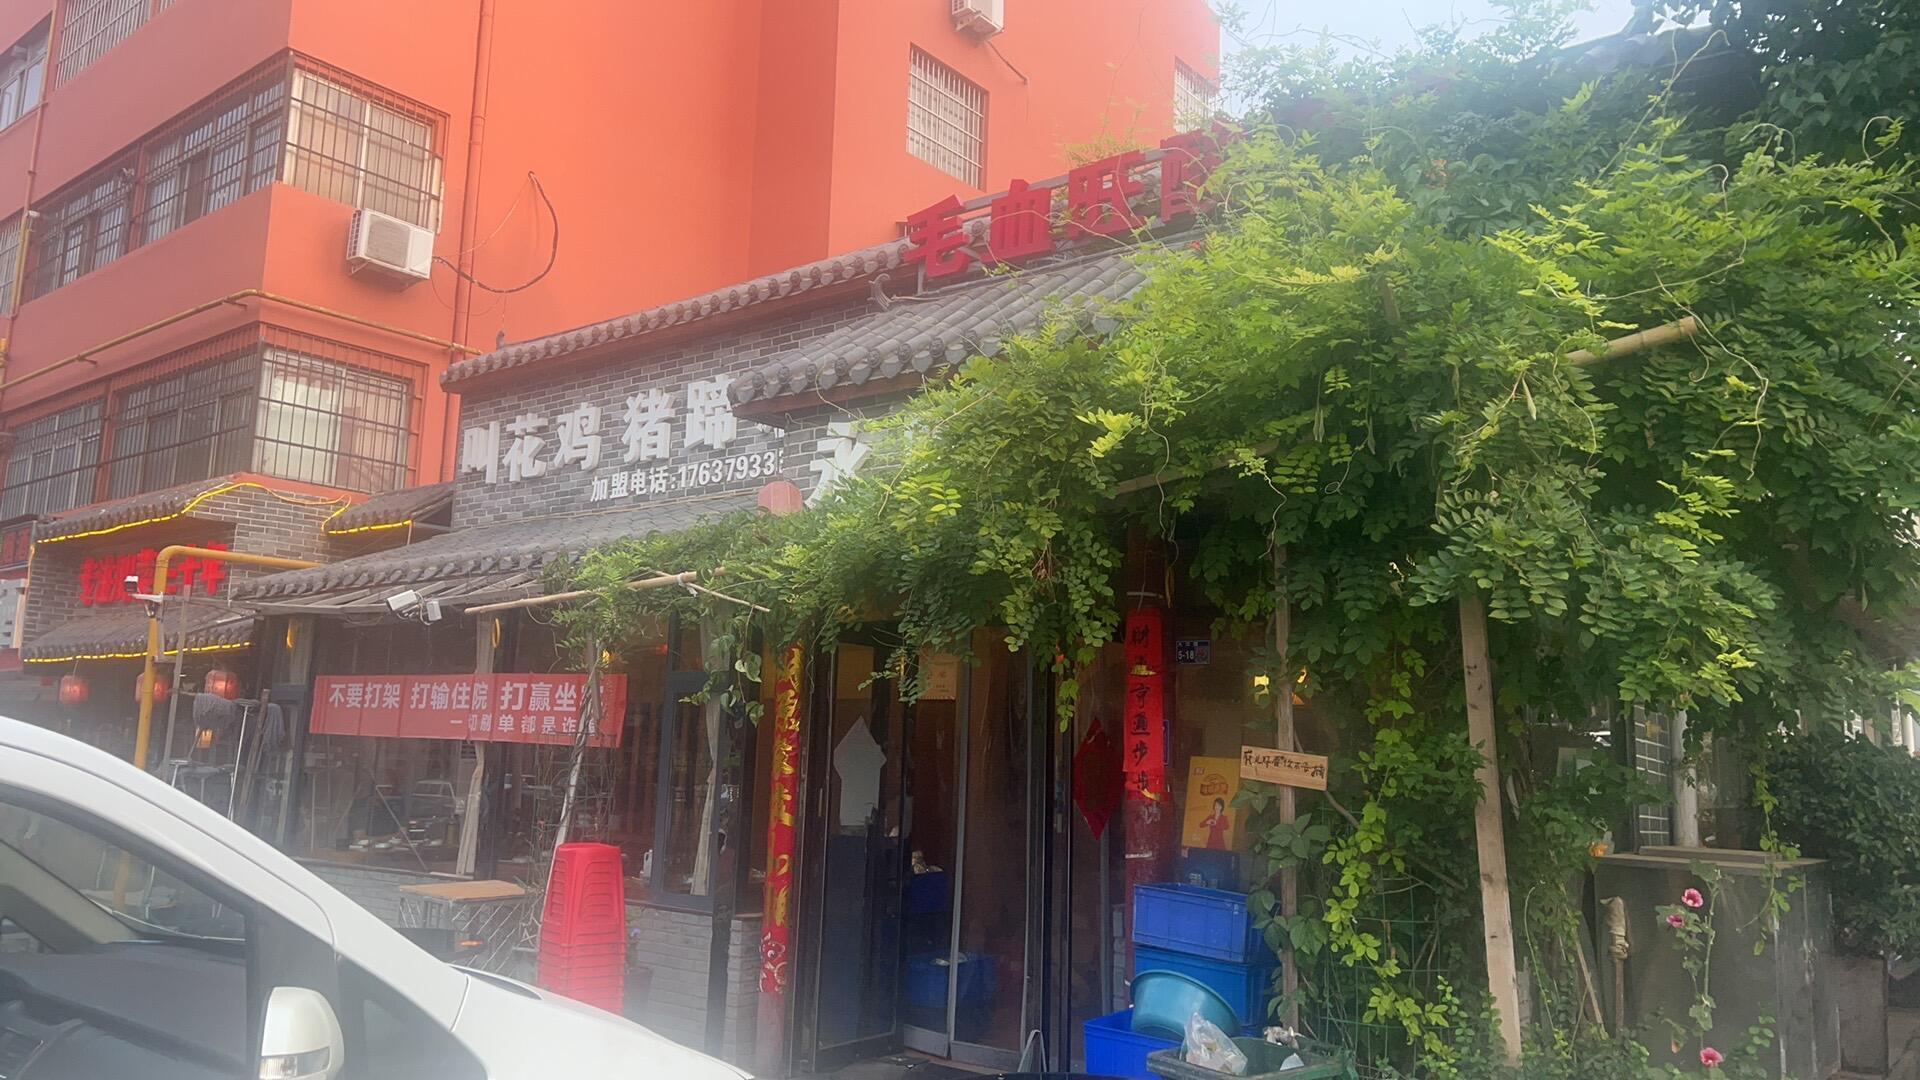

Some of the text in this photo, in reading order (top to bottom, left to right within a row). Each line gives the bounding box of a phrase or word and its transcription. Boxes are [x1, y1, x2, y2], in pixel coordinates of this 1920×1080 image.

[461, 402, 601, 484] 叫花鸡
[328, 681, 604, 712] 不要打架 打输住院 打赢坐
